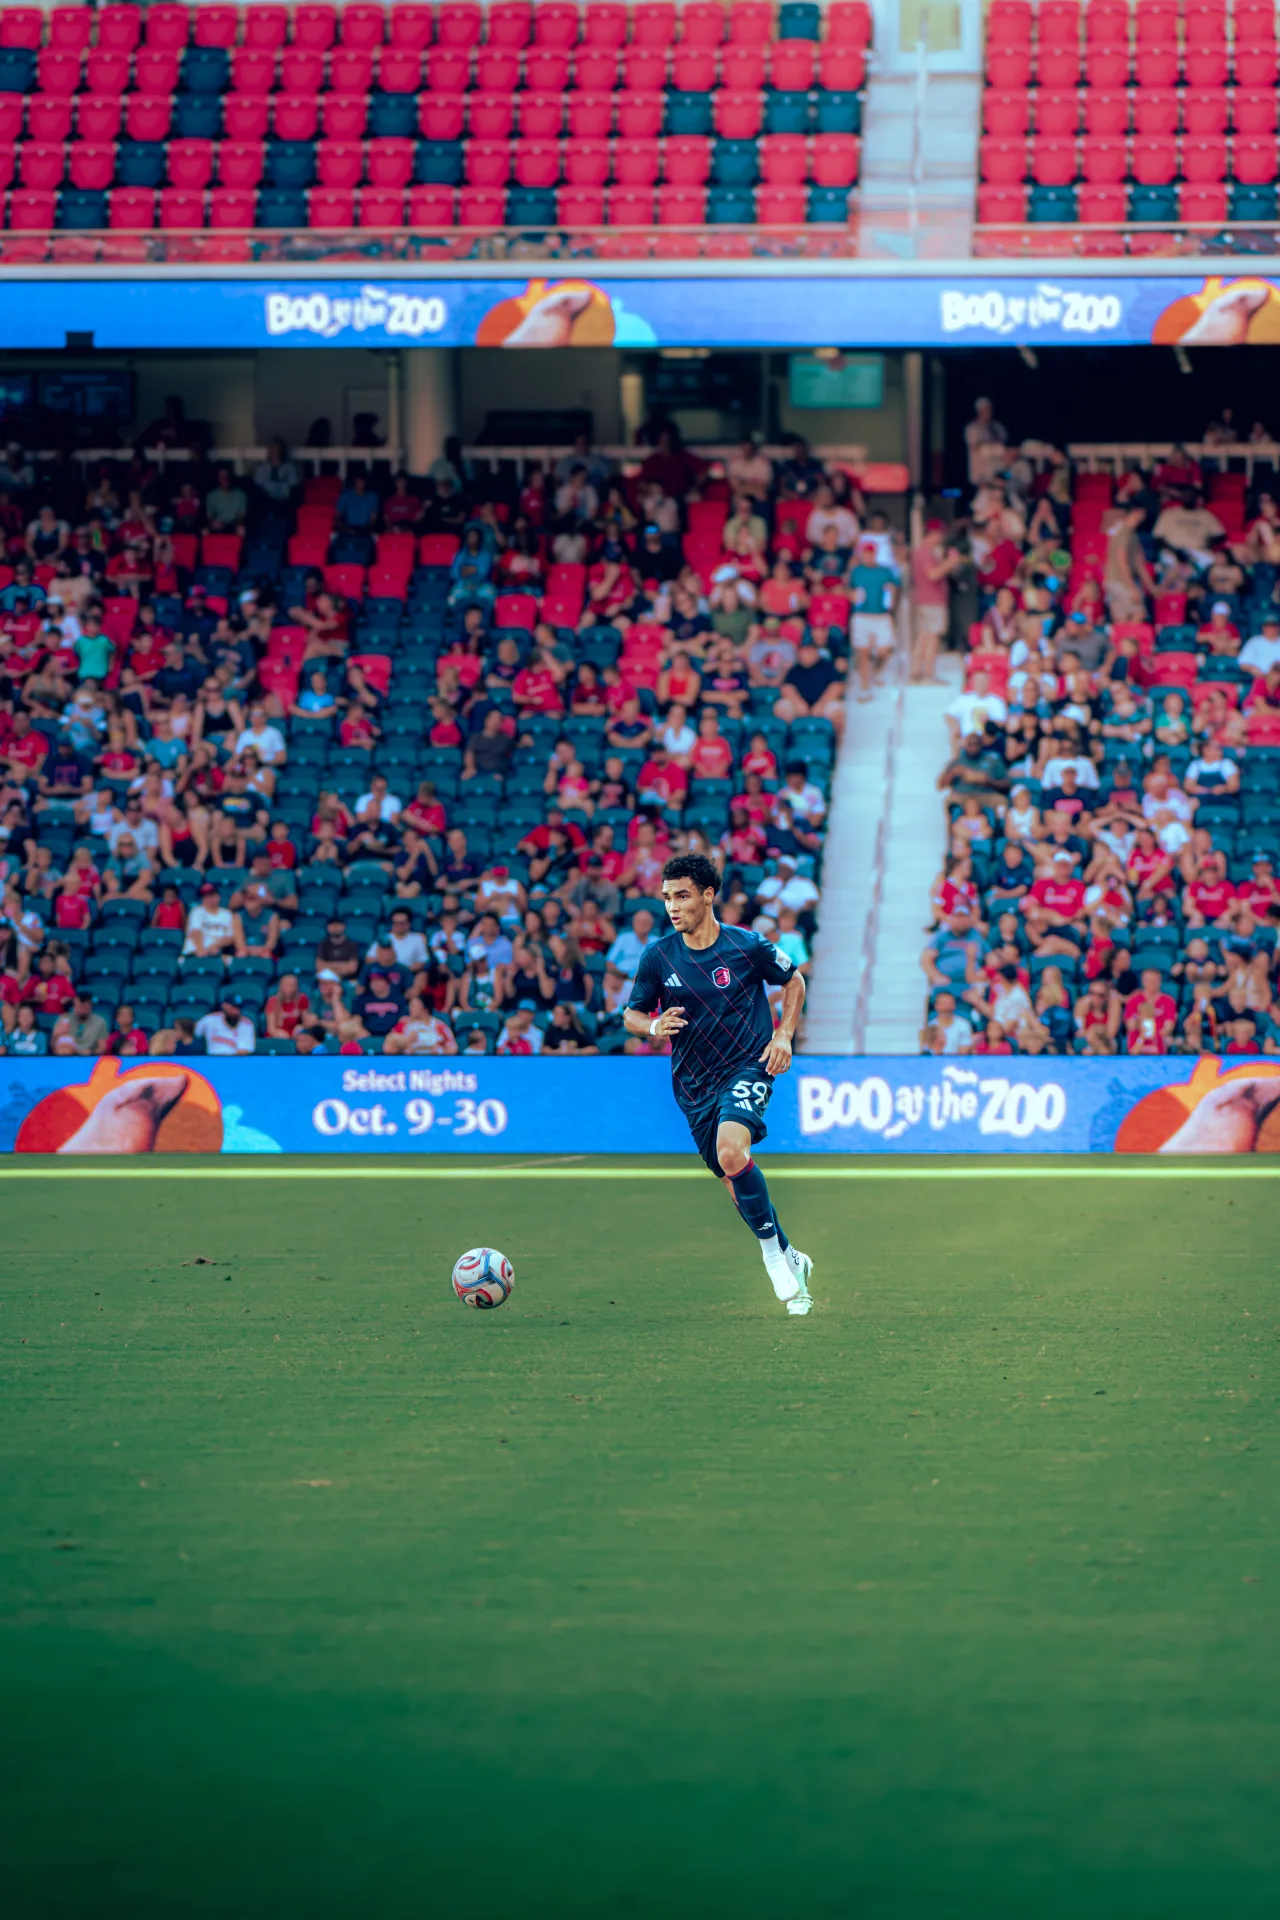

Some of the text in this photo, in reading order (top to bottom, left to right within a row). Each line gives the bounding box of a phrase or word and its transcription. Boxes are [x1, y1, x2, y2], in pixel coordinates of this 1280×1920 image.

[342, 1069, 478, 1097] Select Nights
[731, 1080, 768, 1106] 59
[312, 1098, 508, 1136] Oct. 9-30
[799, 1077, 892, 1134] BOO
[929, 1078, 978, 1129] the
[978, 1079, 1067, 1137] ZOO
